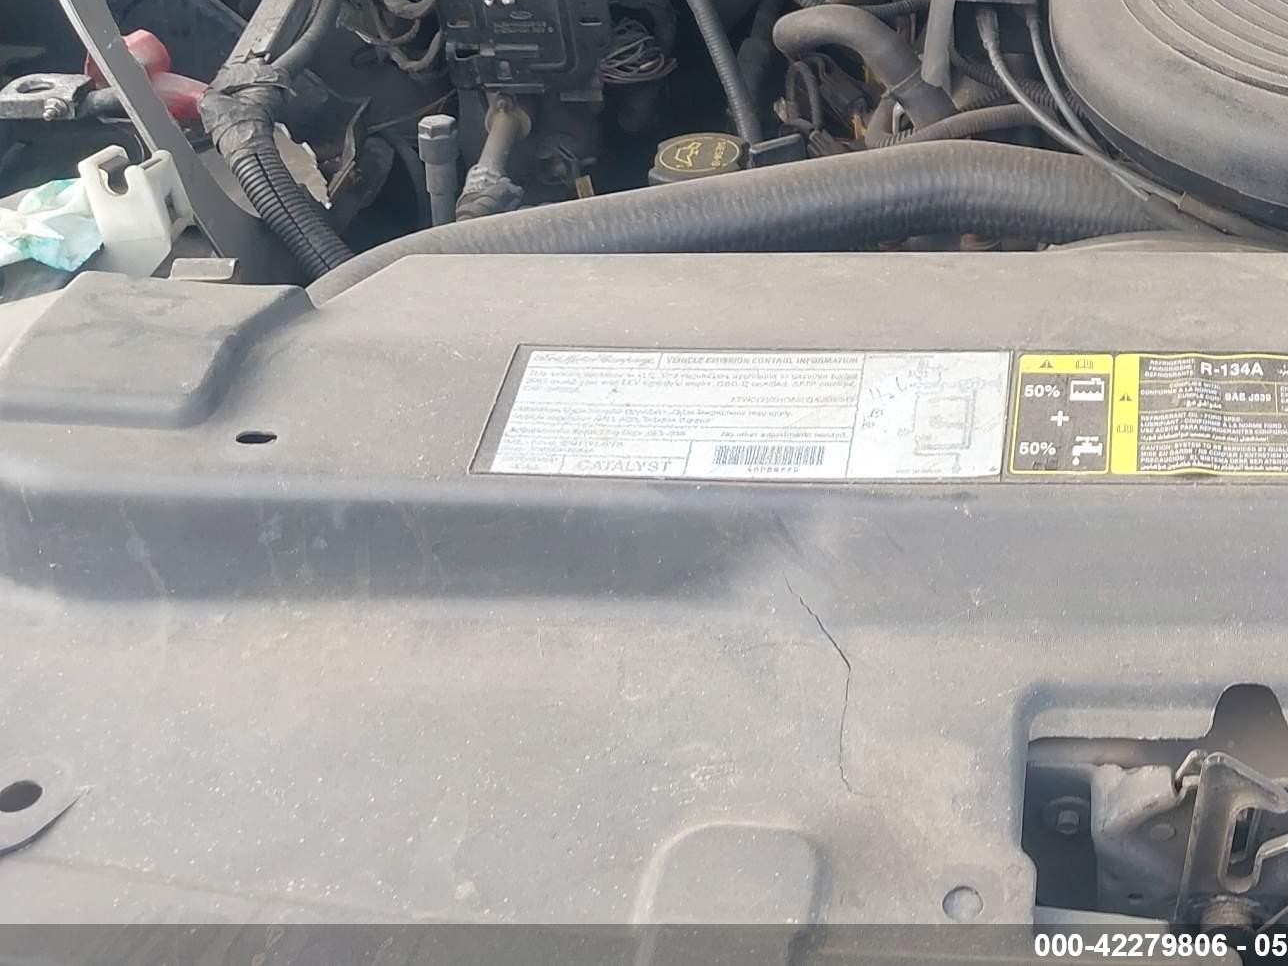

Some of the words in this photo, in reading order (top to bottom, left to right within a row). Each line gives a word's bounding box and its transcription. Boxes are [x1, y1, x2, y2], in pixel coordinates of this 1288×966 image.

[1200, 361, 1264, 377] R-134A
[1023, 385, 1061, 398] 50%
[1018, 441, 1057, 455] 50%
[576, 459, 672, 473] CATALYST
